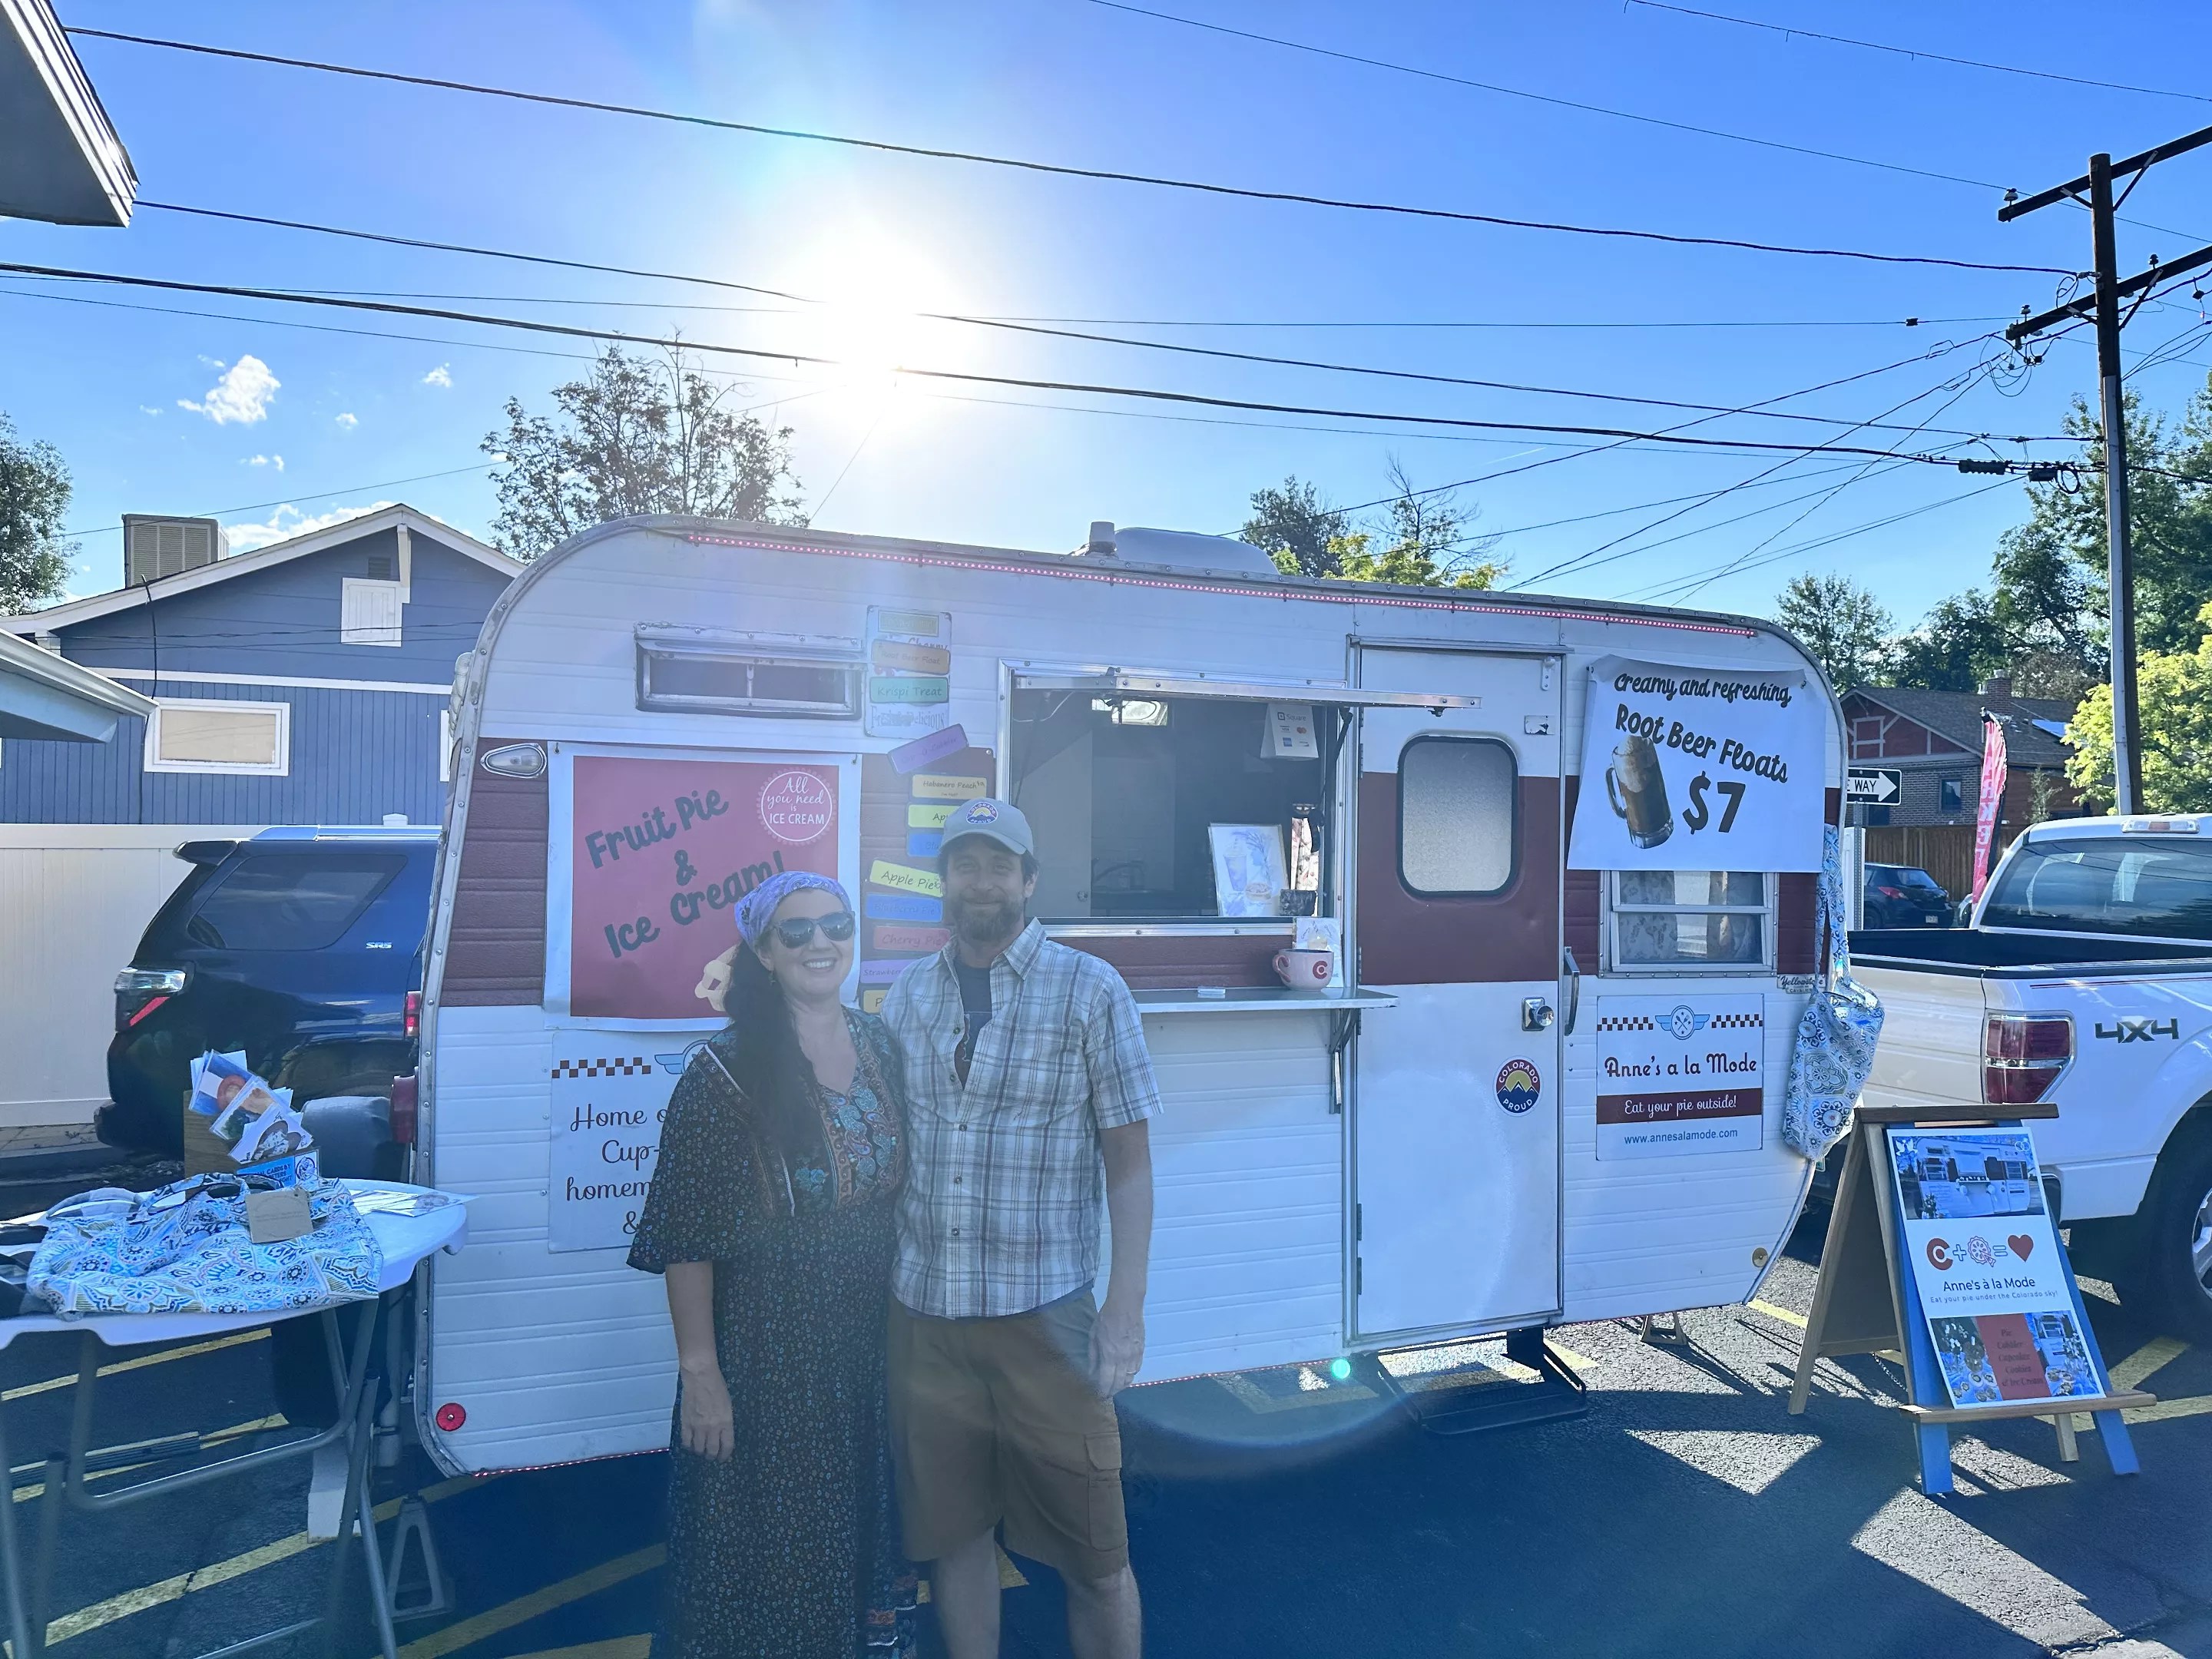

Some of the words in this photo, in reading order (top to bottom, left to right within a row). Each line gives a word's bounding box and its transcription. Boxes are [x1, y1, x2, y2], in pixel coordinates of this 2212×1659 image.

[878, 686, 909, 698] Krispi
[913, 686, 943, 696] Treat
[1614, 674, 1677, 700] Creamy
[1680, 678, 1710, 697] and
[1712, 680, 1792, 707] refreshing
[1615, 704, 1665, 744] Root
[1667, 722, 1717, 759] Beer
[1719, 739, 1788, 783] Floats
[780, 776, 809, 794] All
[957, 781, 977, 790] Peach
[1854, 780, 1876, 793] WAY
[767, 795, 793, 810] you
[796, 789, 825, 804] need
[790, 803, 796, 812] is
[1683, 771, 1746, 835] $7
[770, 813, 785, 824] ICE
[788, 813, 824, 825] CREAM
[585, 806, 677, 869] Fruit
[674, 790, 729, 830] Pie
[674, 849, 697, 886] &
[882, 871, 913, 886] Apple
[918, 878, 933, 889] Pie
[604, 916, 660, 958] Ice
[671, 850, 784, 925] Cream!
[882, 934, 920, 947] Cherry
[926, 935, 941, 945] Pie
[1498, 1061, 1538, 1083] COLORADO
[1604, 1055, 1661, 1077] Anne's
[1667, 1064, 1678, 1075] a
[1685, 1055, 1700, 1075] la
[1706, 1052, 1757, 1073] Mode
[1503, 1098, 1532, 1111] PROUD
[1624, 1100, 1645, 1114] Eat
[1647, 1103, 1673, 1118] your
[1676, 1098, 1694, 1117] pie
[1697, 1094, 1737, 1109] outside!
[570, 1104, 647, 1132] Home
[1624, 1128, 1738, 1144] www.annesalamode.com
[623, 1211, 638, 1234] &
[1943, 1280, 1981, 1292] Anne's
[1983, 1279, 1990, 1290] à
[1992, 1278, 2002, 1289] la
[2004, 1276, 2035, 1288] Mode
[1944, 1296, 1960, 1304] your
[2045, 1290, 2059, 1298] sky!
